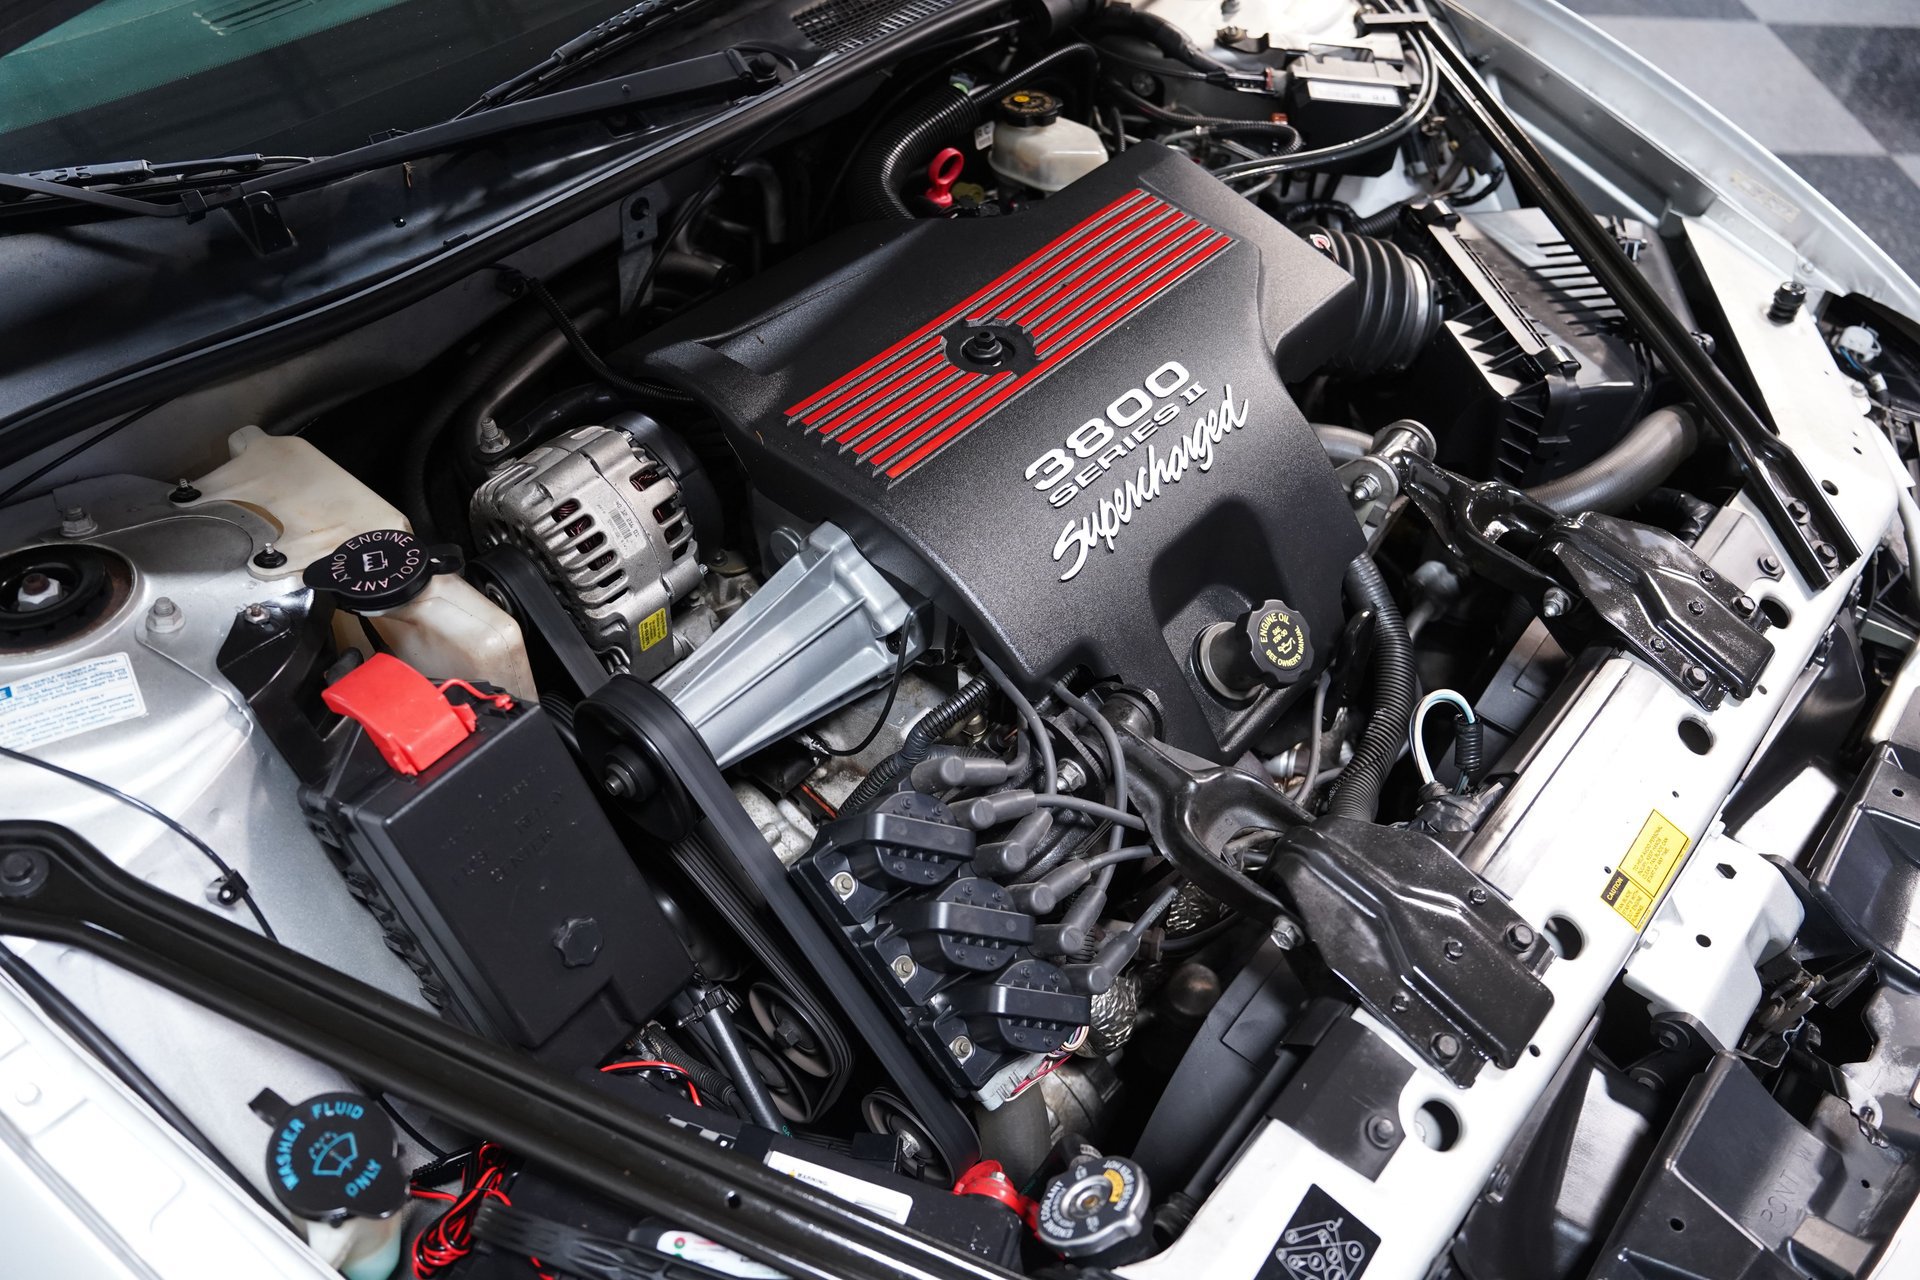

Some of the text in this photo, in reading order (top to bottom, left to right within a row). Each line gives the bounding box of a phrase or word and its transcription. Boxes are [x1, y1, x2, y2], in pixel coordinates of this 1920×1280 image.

[1025, 361, 1190, 491] 3800
[1049, 381, 1207, 508] SERIES II
[1053, 384, 1249, 582] Supercharged
[331, 531, 420, 592] ENGINE COOLANT ONLY
[1260, 612, 1290, 643] ENGINE OIL
[1265, 649, 1278, 662] SEE
[1294, 625, 1305, 654] MANUAL
[1606, 876, 1624, 901] CAUTION
[275, 1101, 382, 1198] WASHER FLUID ONLY
[1040, 1181, 1064, 1221] COOLANT
[1043, 1218, 1074, 1239] ENGINE
